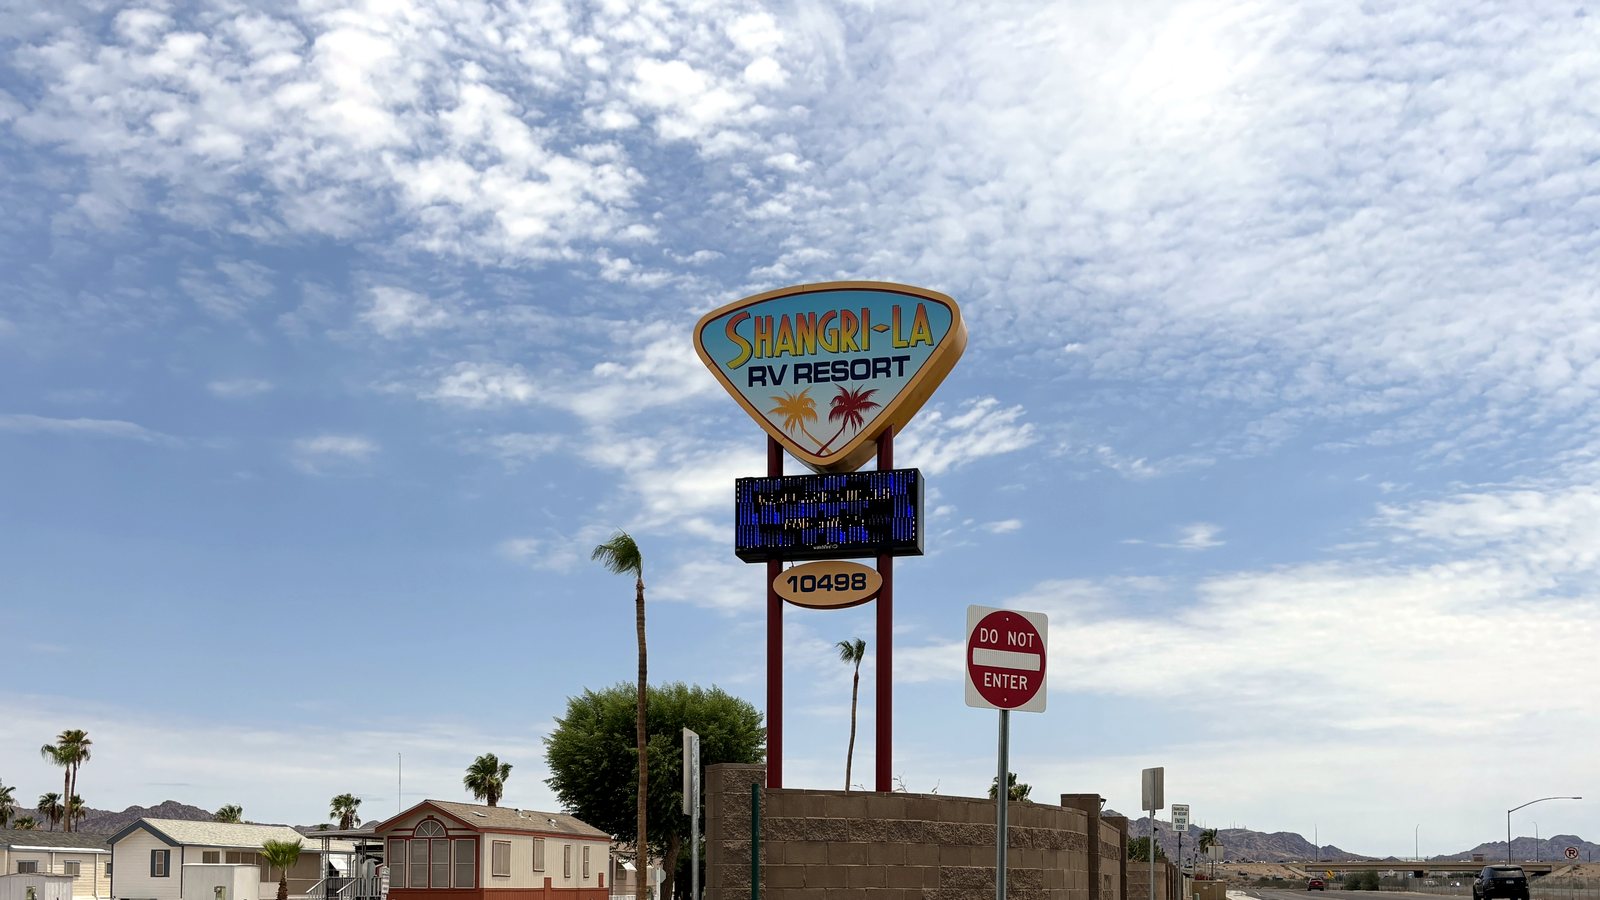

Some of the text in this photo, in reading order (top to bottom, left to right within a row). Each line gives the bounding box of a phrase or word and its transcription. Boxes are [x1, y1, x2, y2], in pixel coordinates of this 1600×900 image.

[725, 303, 934, 370] SHANGRI-LA
[748, 355, 910, 387] RV RESORT
[786, 573, 866, 593] 10498
[980, 627, 1034, 647] DO NOT
[984, 672, 1028, 690] ENTER
